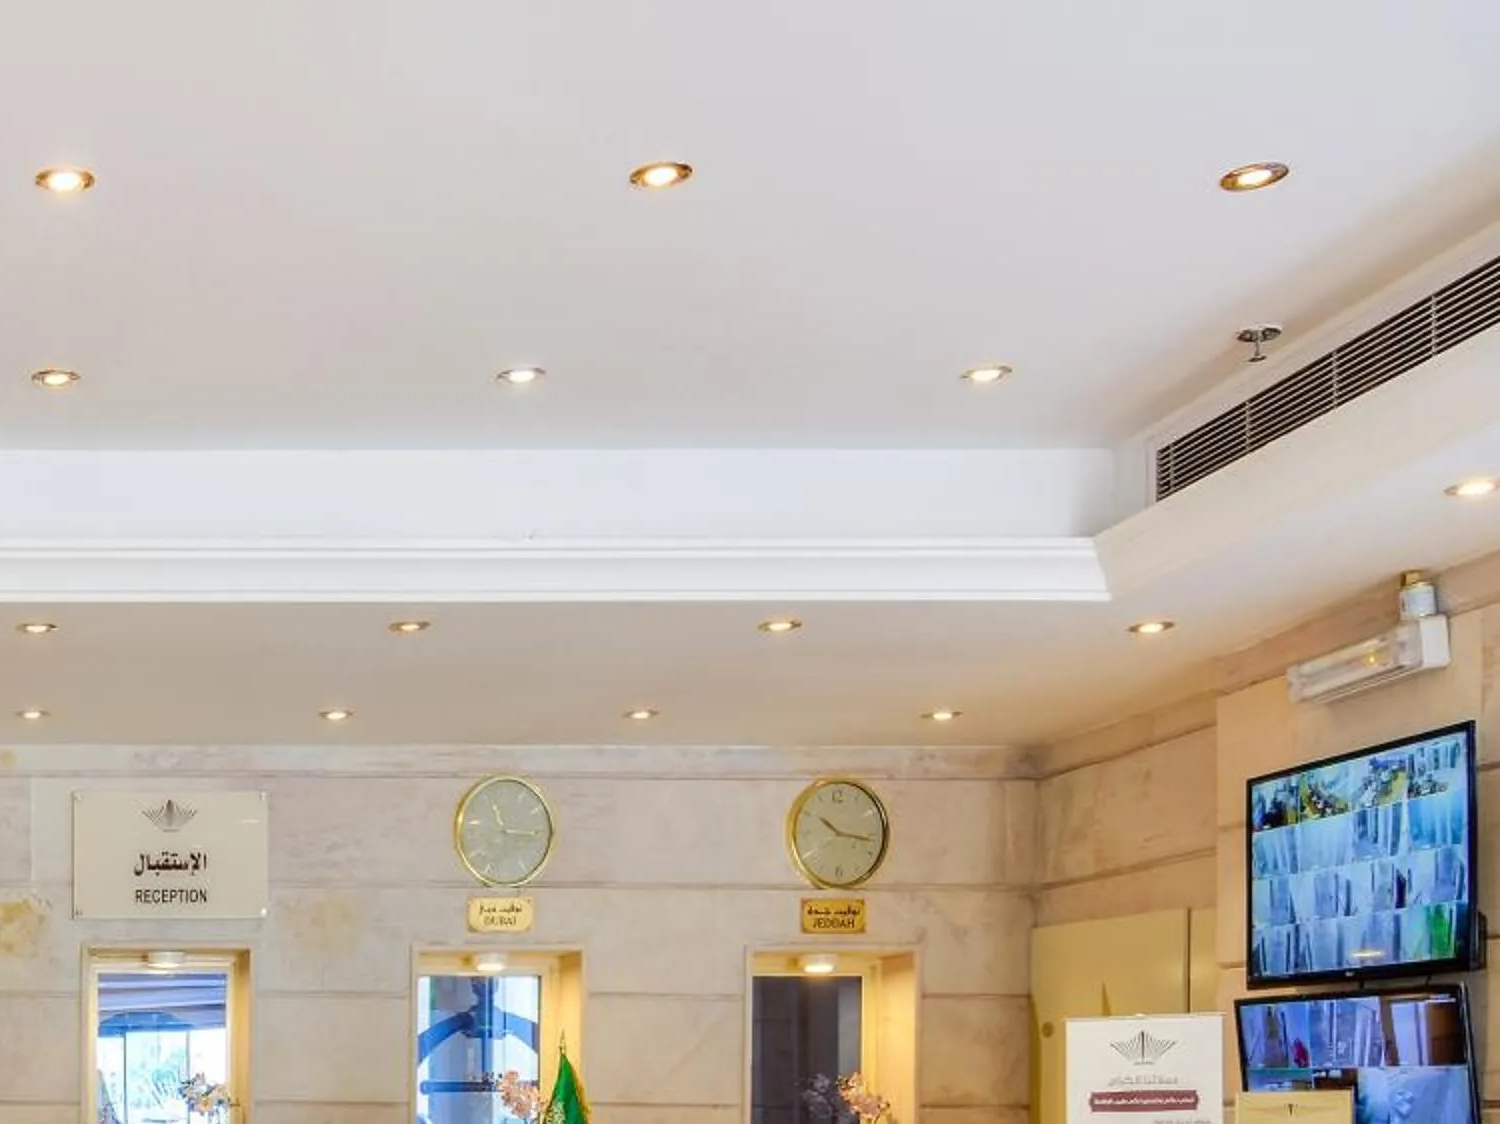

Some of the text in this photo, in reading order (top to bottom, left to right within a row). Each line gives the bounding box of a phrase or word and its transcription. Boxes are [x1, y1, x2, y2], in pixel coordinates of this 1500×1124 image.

[135, 889, 207, 904] RECEPTION
[483, 915, 516, 926] DUBAI
[813, 918, 855, 929] JEDDAH
